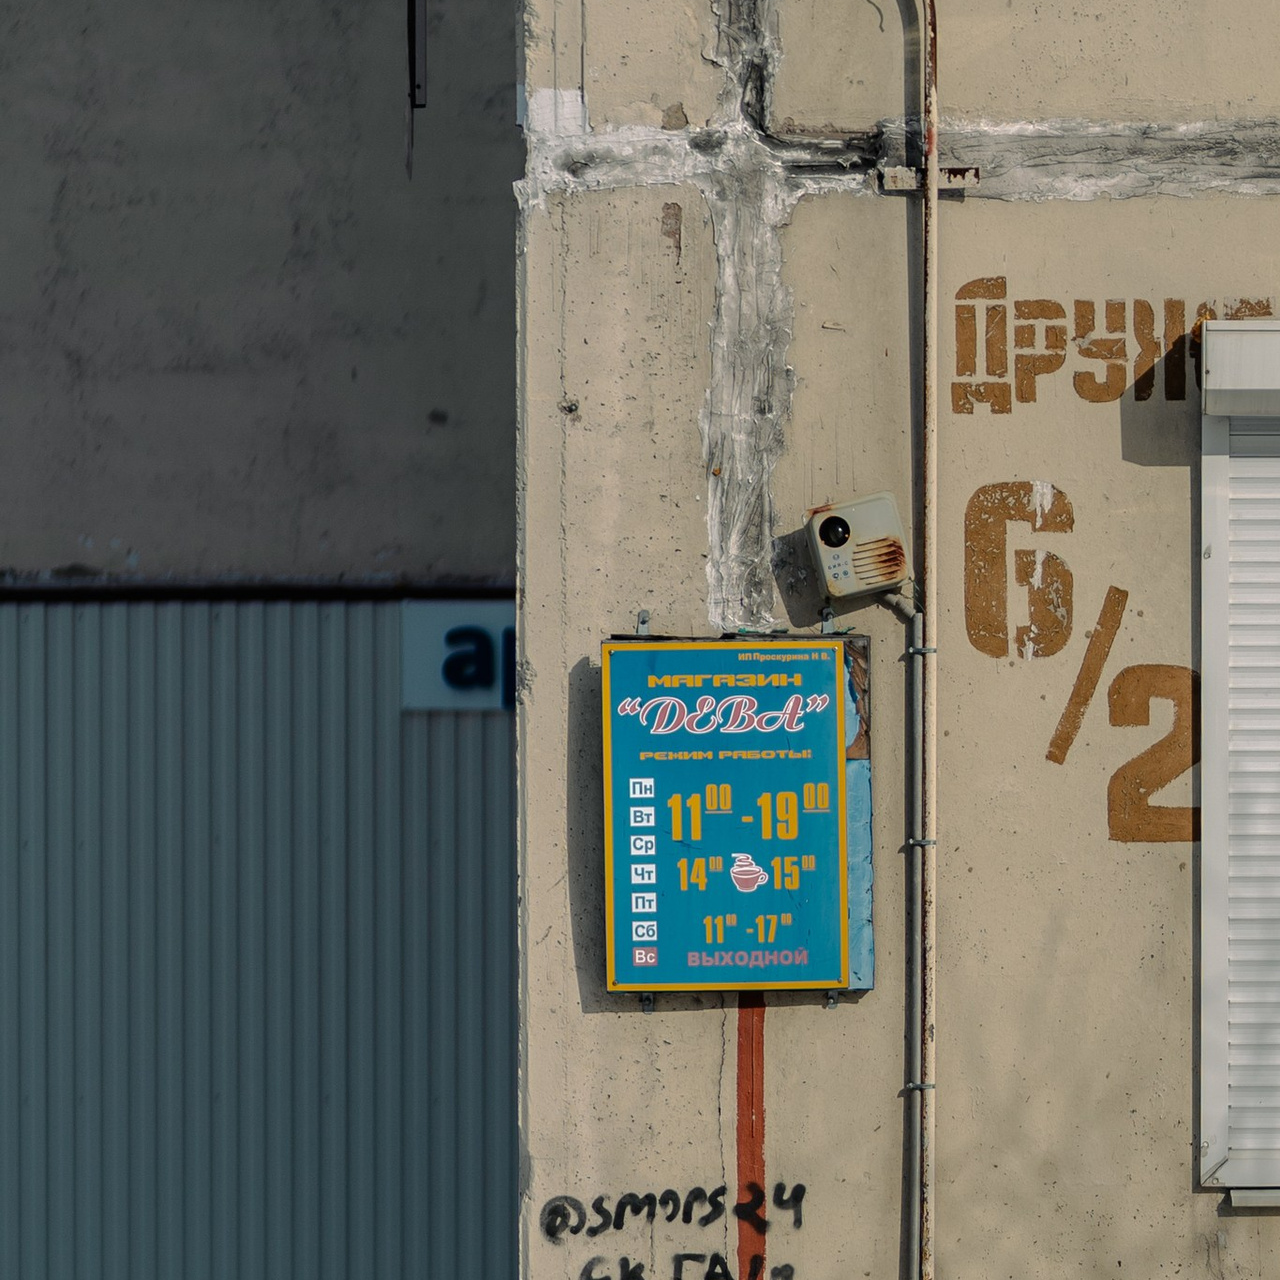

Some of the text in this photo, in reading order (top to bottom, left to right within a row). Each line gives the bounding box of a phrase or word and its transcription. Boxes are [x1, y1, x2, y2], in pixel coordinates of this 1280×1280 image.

[738, 652, 752, 661] ИП
[647, 673, 803, 688] МАГАЗИН
[639, 749, 813, 761] РЕЖИМ РАБОТЫ:
[631, 781, 653, 796] Пн
[632, 809, 653, 824] Вт
[632, 837, 654, 853] Ср
[633, 867, 654, 881] Чт
[634, 895, 655, 910] Пт
[634, 924, 656, 938] Сб
[635, 949, 656, 963] Вс
[687, 947, 809, 968] ВЫХОДНОЙ
